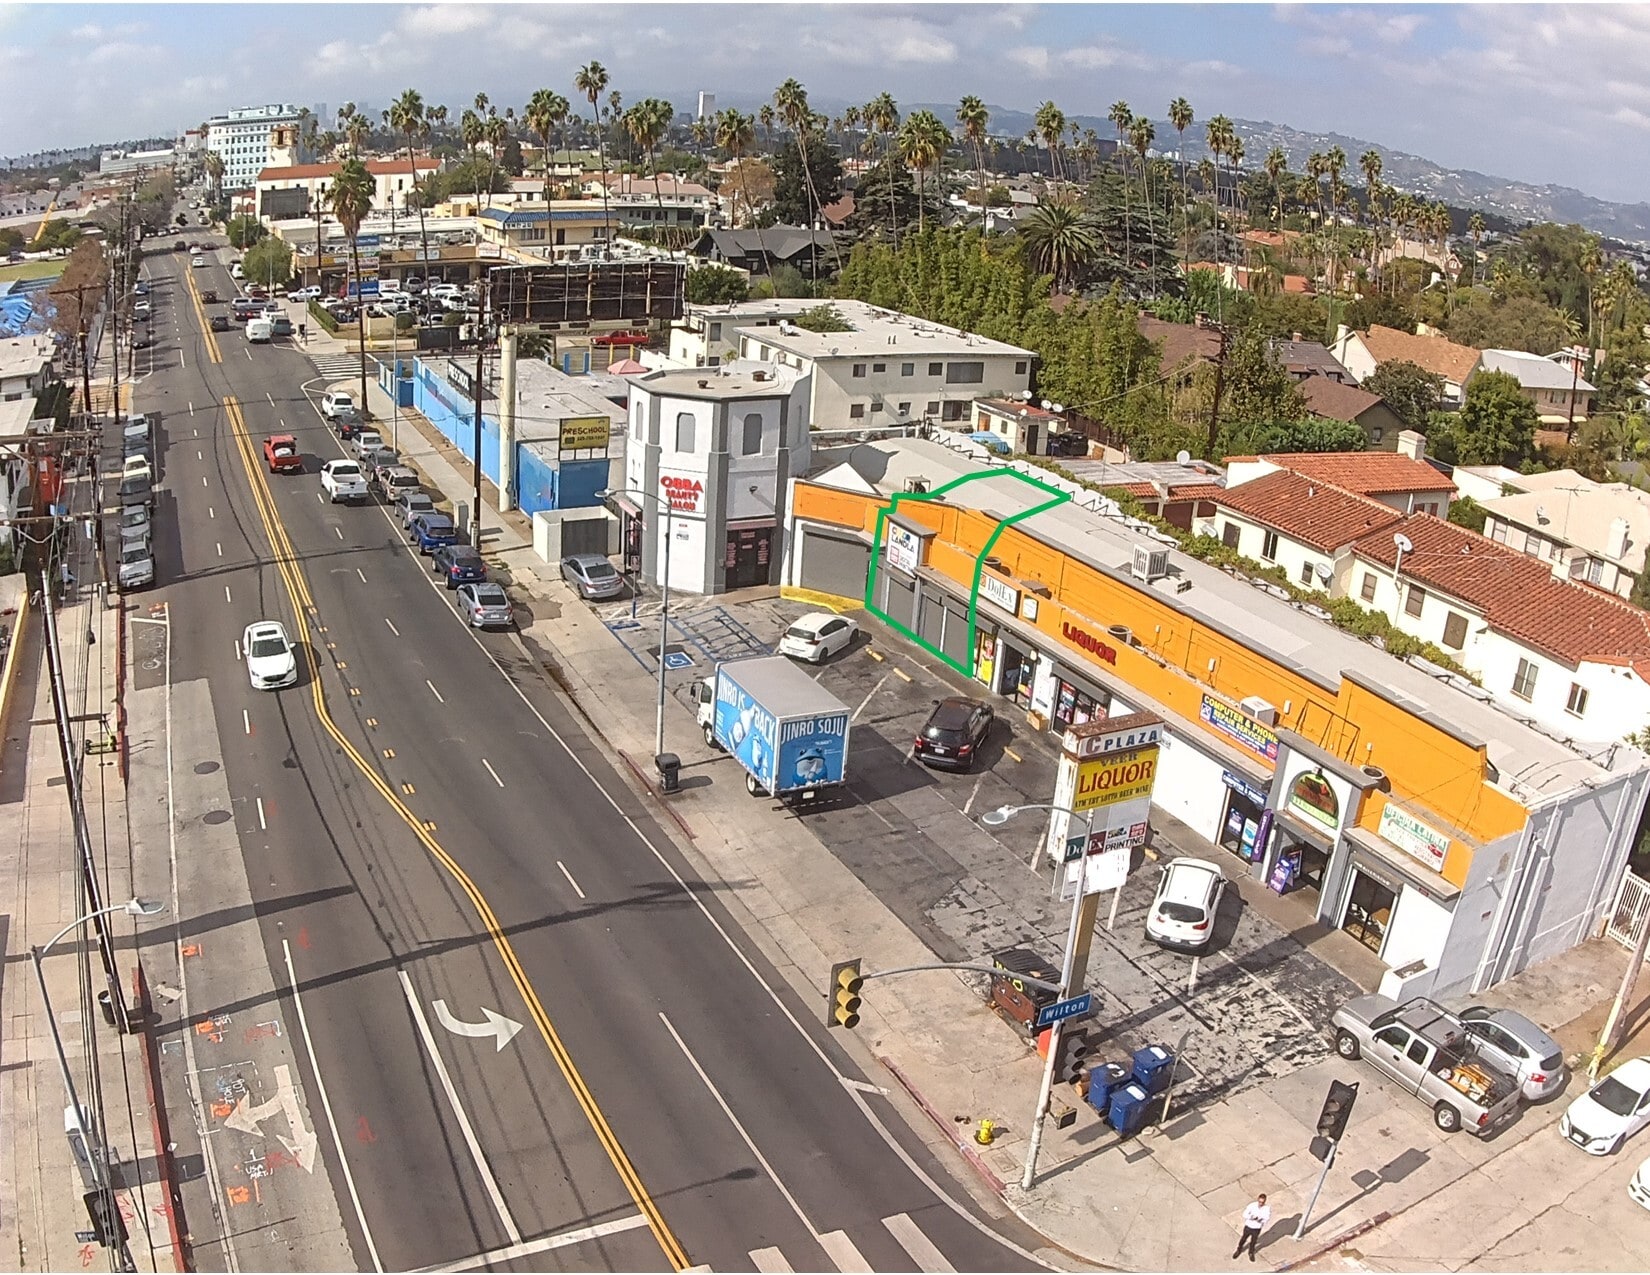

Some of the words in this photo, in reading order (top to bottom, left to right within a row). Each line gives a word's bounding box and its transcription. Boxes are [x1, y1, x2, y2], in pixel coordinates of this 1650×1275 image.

[562, 426, 607, 436] PRESCHOOL
[660, 475, 704, 493] OBBA
[671, 500, 696, 511] ALON
[1063, 621, 1117, 667] LIQUOR
[1204, 695, 1244, 724] COMPUTER
[1244, 719, 1251, 729] &
[781, 720, 814, 745] JINRO
[818, 716, 844, 737] SOJU
[1213, 708, 1235, 728] REPAIR
[1236, 723, 1266, 745] SERVICES
[1104, 730, 1158, 751] PLAZA
[1079, 760, 1154, 795] LIQUOR
[1135, 784, 1149, 794] WINE
[1105, 836, 1144, 853] PRINTING
[1045, 1001, 1085, 1020] Wilton
